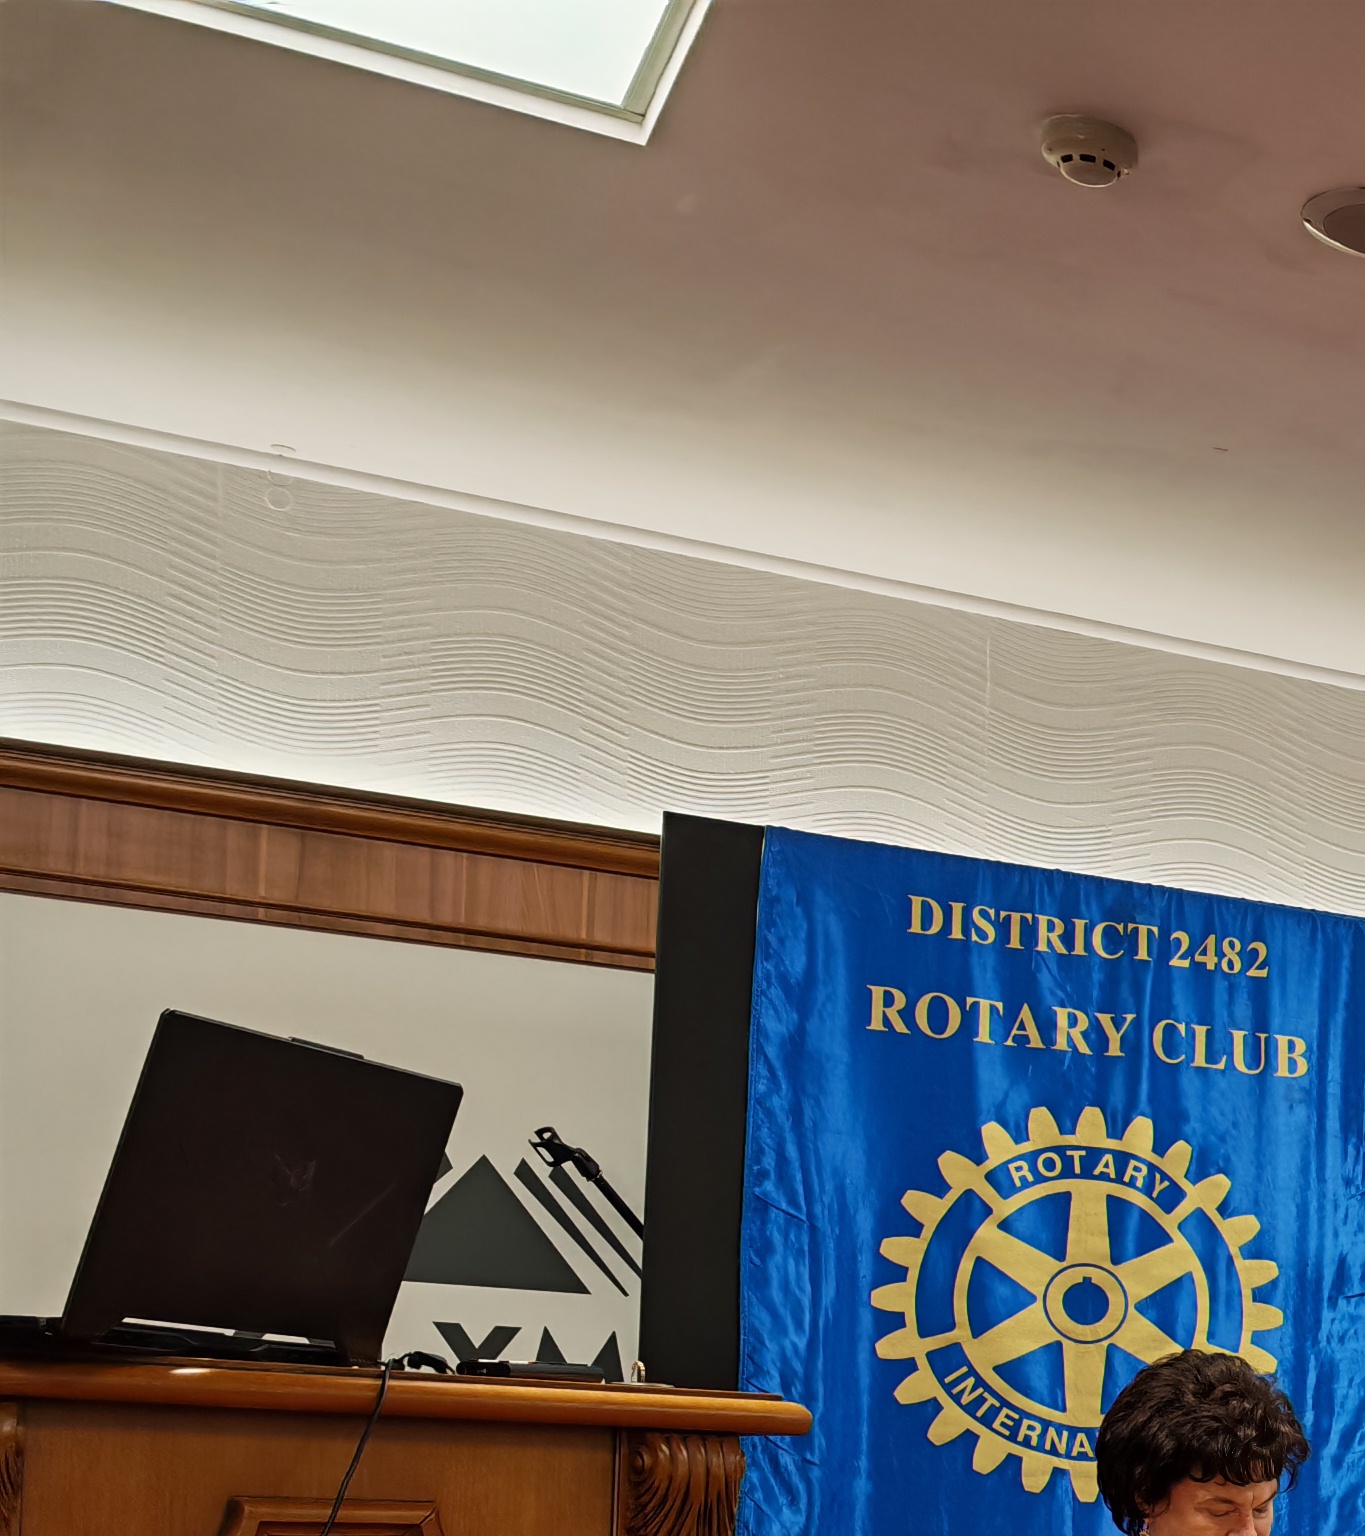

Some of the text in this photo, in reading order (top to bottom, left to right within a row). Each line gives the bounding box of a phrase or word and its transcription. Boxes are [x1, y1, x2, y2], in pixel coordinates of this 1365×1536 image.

[906, 894, 1271, 979] DISTRICT 2482
[864, 984, 1309, 1079] ROTARY CLUB
[1007, 1149, 1171, 1199] ROTARY
[943, 1365, 1096, 1459] INTERNA
